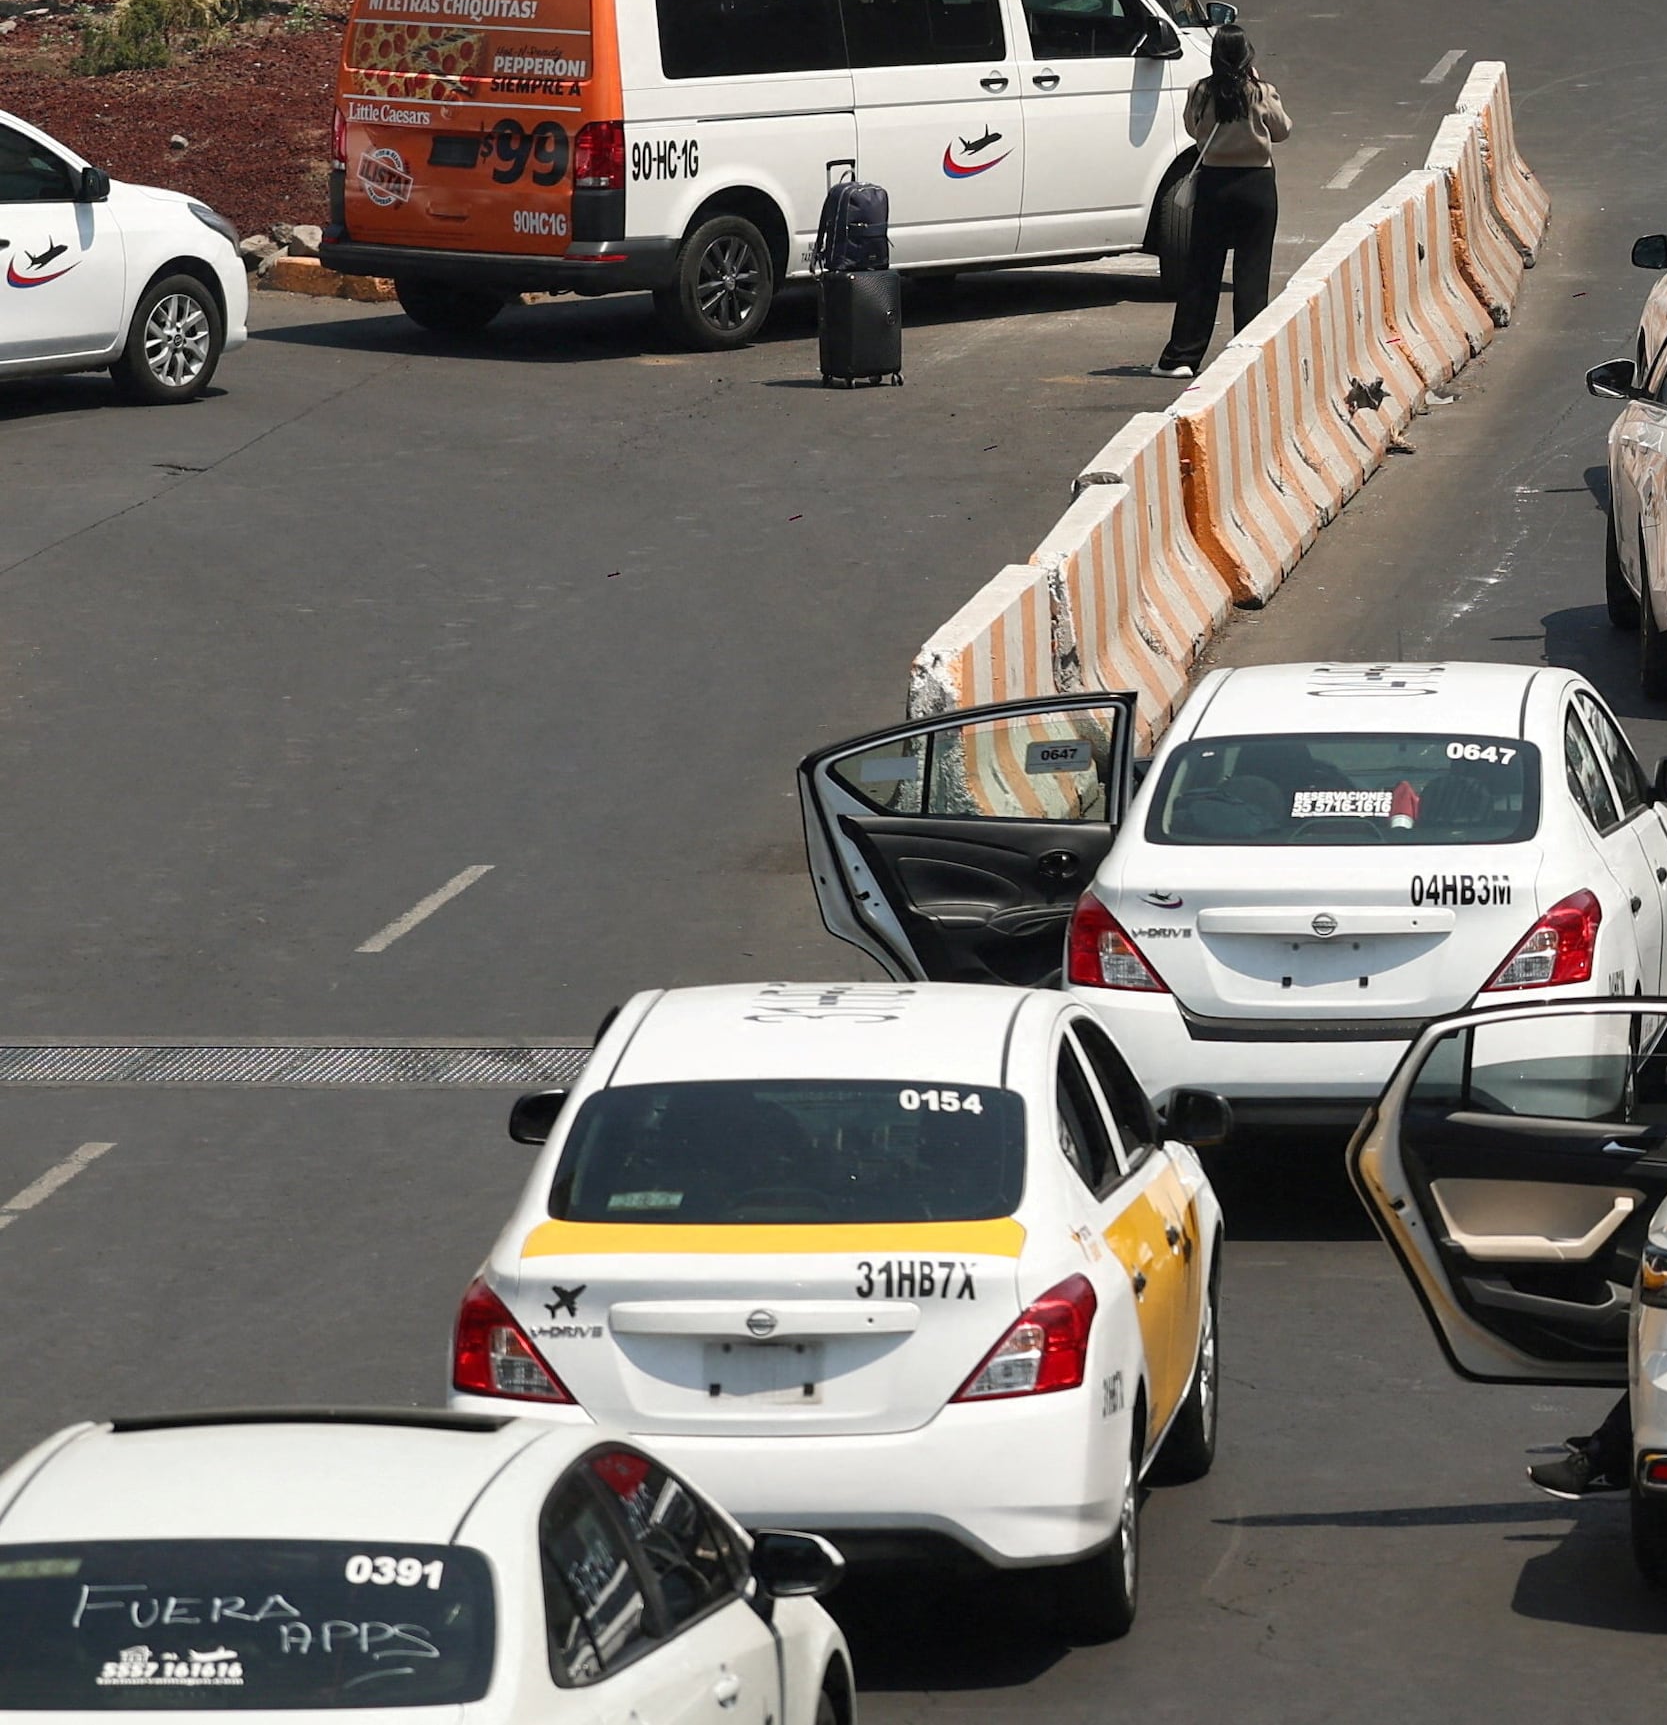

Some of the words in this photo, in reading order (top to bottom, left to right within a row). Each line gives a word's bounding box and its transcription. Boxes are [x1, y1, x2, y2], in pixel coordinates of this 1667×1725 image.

[493, 56, 588, 79] PEPPERONI
[489, 77, 564, 96] SIEMPRE
[568, 80, 582, 97] A
[348, 100, 379, 123] Little
[379, 104, 431, 126] Caesars
[632, 139, 699, 182] 90-HC-1G
[513, 210, 568, 236] 90HC1G
[1040, 748, 1078, 762] 0647
[1445, 741, 1517, 766] 0647
[1292, 801, 1313, 813] 55
[1314, 801, 1391, 813] 5716-1616
[1293, 790, 1393, 802] RESERVACIONES
[1410, 874, 1512, 907] 04HB3M
[899, 1088, 984, 1115] 0154
[854, 1259, 978, 1302] 31HB7X
[345, 1554, 446, 1591] 0391
[280, 1621, 442, 1661] APPS
